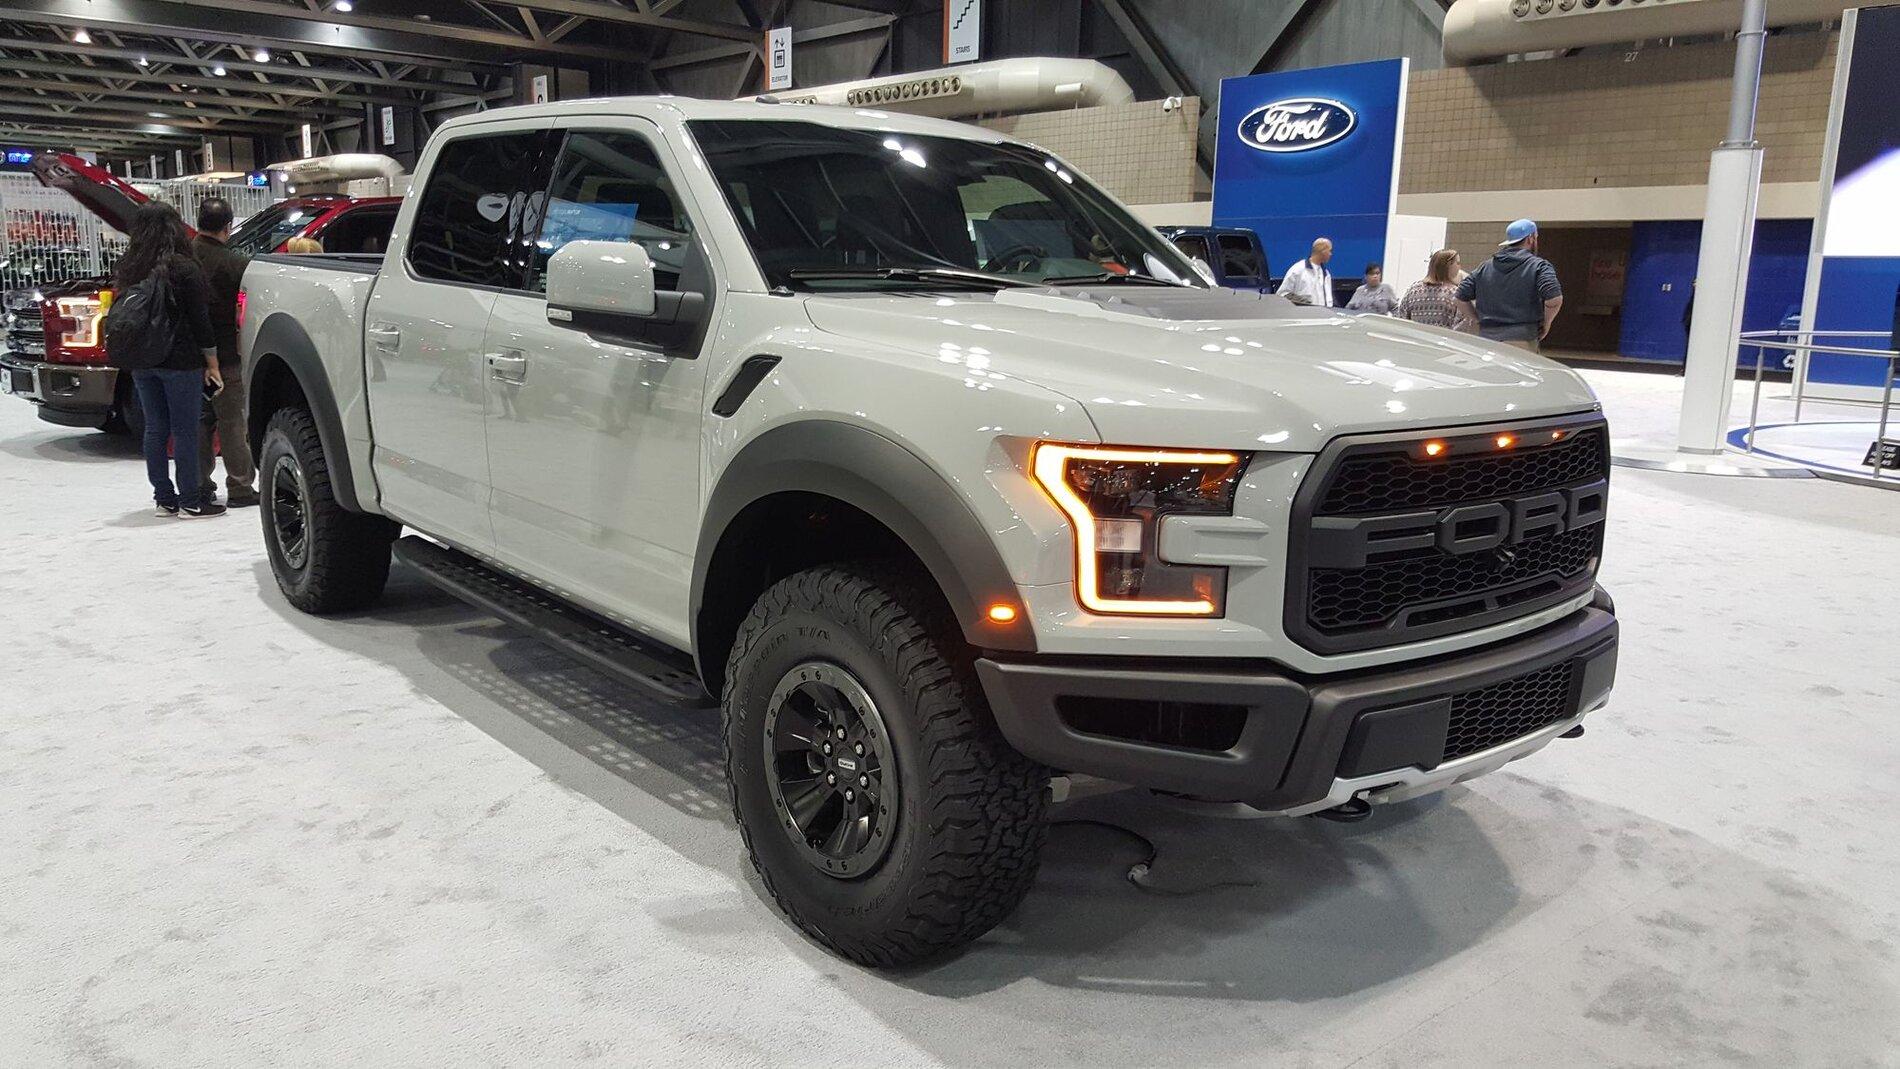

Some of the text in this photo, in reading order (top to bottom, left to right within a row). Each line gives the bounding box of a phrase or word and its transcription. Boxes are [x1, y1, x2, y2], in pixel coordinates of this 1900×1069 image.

[1624, 51, 1639, 62] 27
[1256, 104, 1330, 143] Ford
[1308, 478, 1607, 568] FORD
